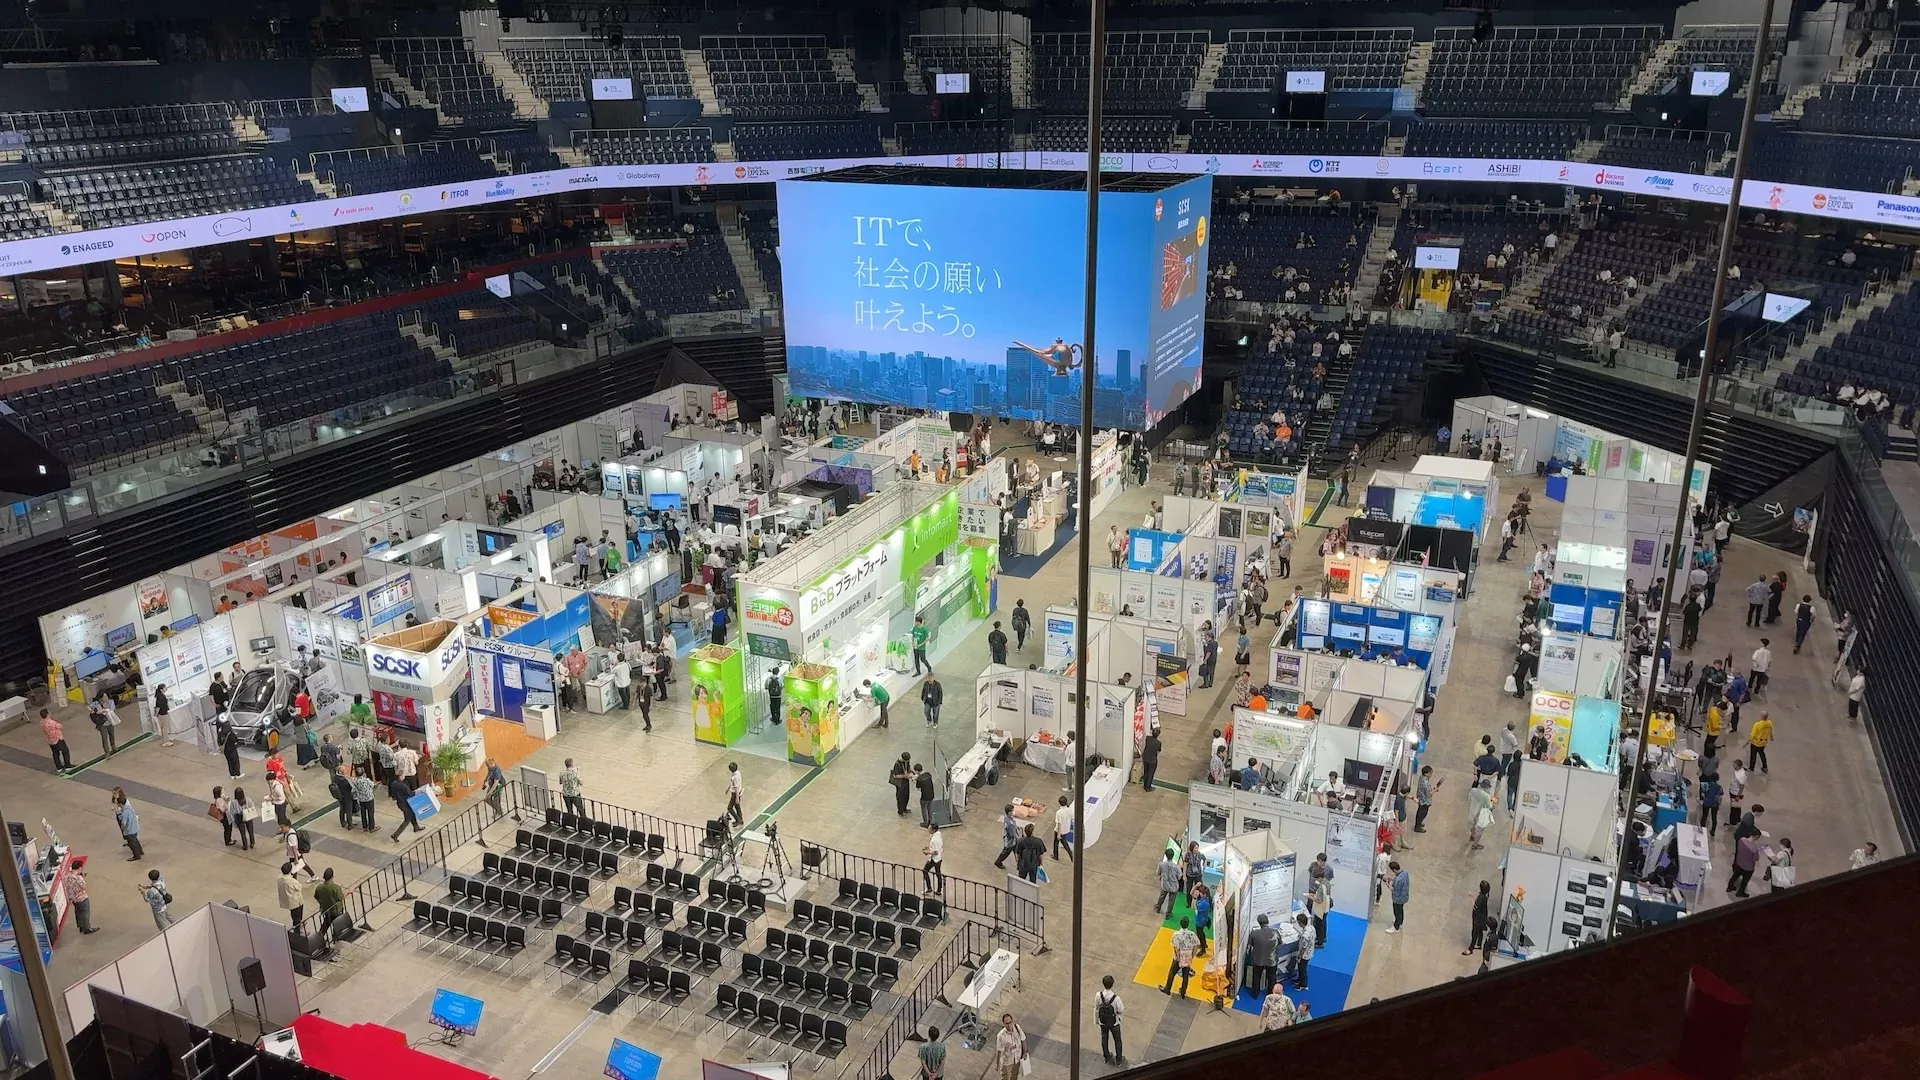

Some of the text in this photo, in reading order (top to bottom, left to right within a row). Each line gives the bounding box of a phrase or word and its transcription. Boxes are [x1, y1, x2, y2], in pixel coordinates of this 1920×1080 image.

[1050, 158, 1076, 166] SoftBank
[450, 189, 469, 199] ITFOR
[72, 240, 114, 253] ENAGEED
[853, 216, 932, 251] ITで、
[853, 256, 1002, 295] 社会の願い
[855, 299, 976, 338] 叶えよう。
[921, 512, 952, 543] infomart
[1360, 530, 1385, 538] ELECOM
[373, 653, 422, 680] SCSK
[442, 635, 464, 671] SCSK
[1536, 697, 1570, 710] OCC
